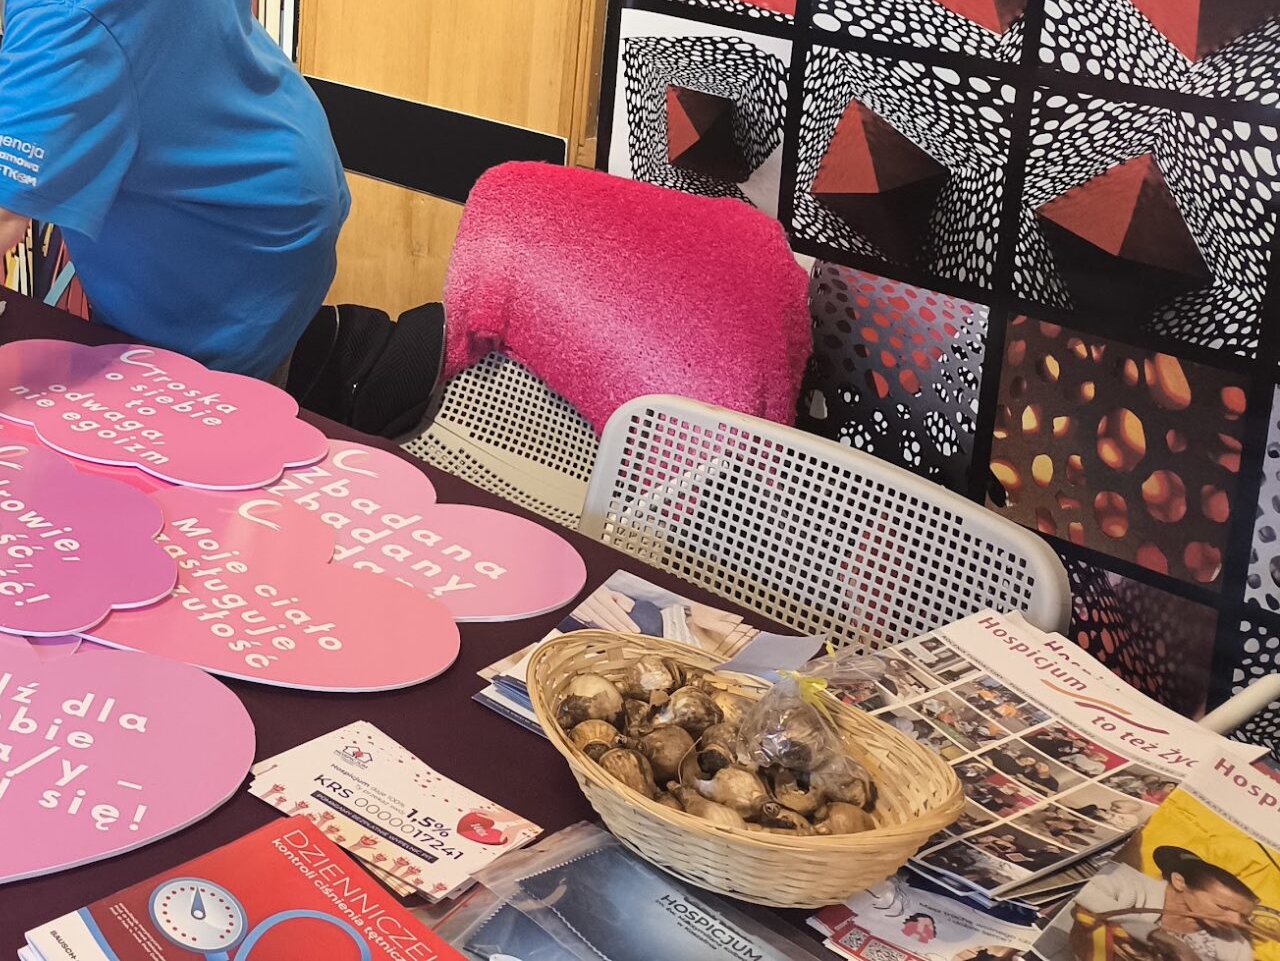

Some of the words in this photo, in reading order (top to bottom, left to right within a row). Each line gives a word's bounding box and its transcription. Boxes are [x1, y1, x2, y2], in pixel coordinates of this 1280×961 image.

[48, 384, 166, 446] odwaga,
[104, 372, 124, 381] o
[130, 383, 223, 426] siebie
[125, 399, 157, 416] to
[142, 367, 238, 414] Troska
[9, 385, 55, 408] nie
[62, 412, 169, 465] egoizm
[291, 466, 508, 580] Zbadana
[153, 532, 296, 652] zasługuje
[171, 517, 249, 574] Moje
[254, 584, 343, 651] ciało
[173, 585, 278, 669] zułość
[977, 616, 1088, 713] Hospicjum
[61, 692, 149, 733] dla
[1091, 715, 1117, 732] to
[1120, 731, 1160, 753] też
[38, 789, 148, 832] się!
[313, 774, 354, 800] KRS
[354, 797, 464, 860] 0000017241
[406, 808, 450, 838] 1,5%
[272, 837, 317, 879] kontroli
[314, 879, 364, 927] ciśnienia
[363, 923, 408, 961] tętnicz
[283, 829, 438, 961] DZIENNICZE
[50, 929, 80, 961] BAUSCH+
[660, 894, 763, 961] HOSPICJUM
[723, 945, 753, 961] Kolbe
